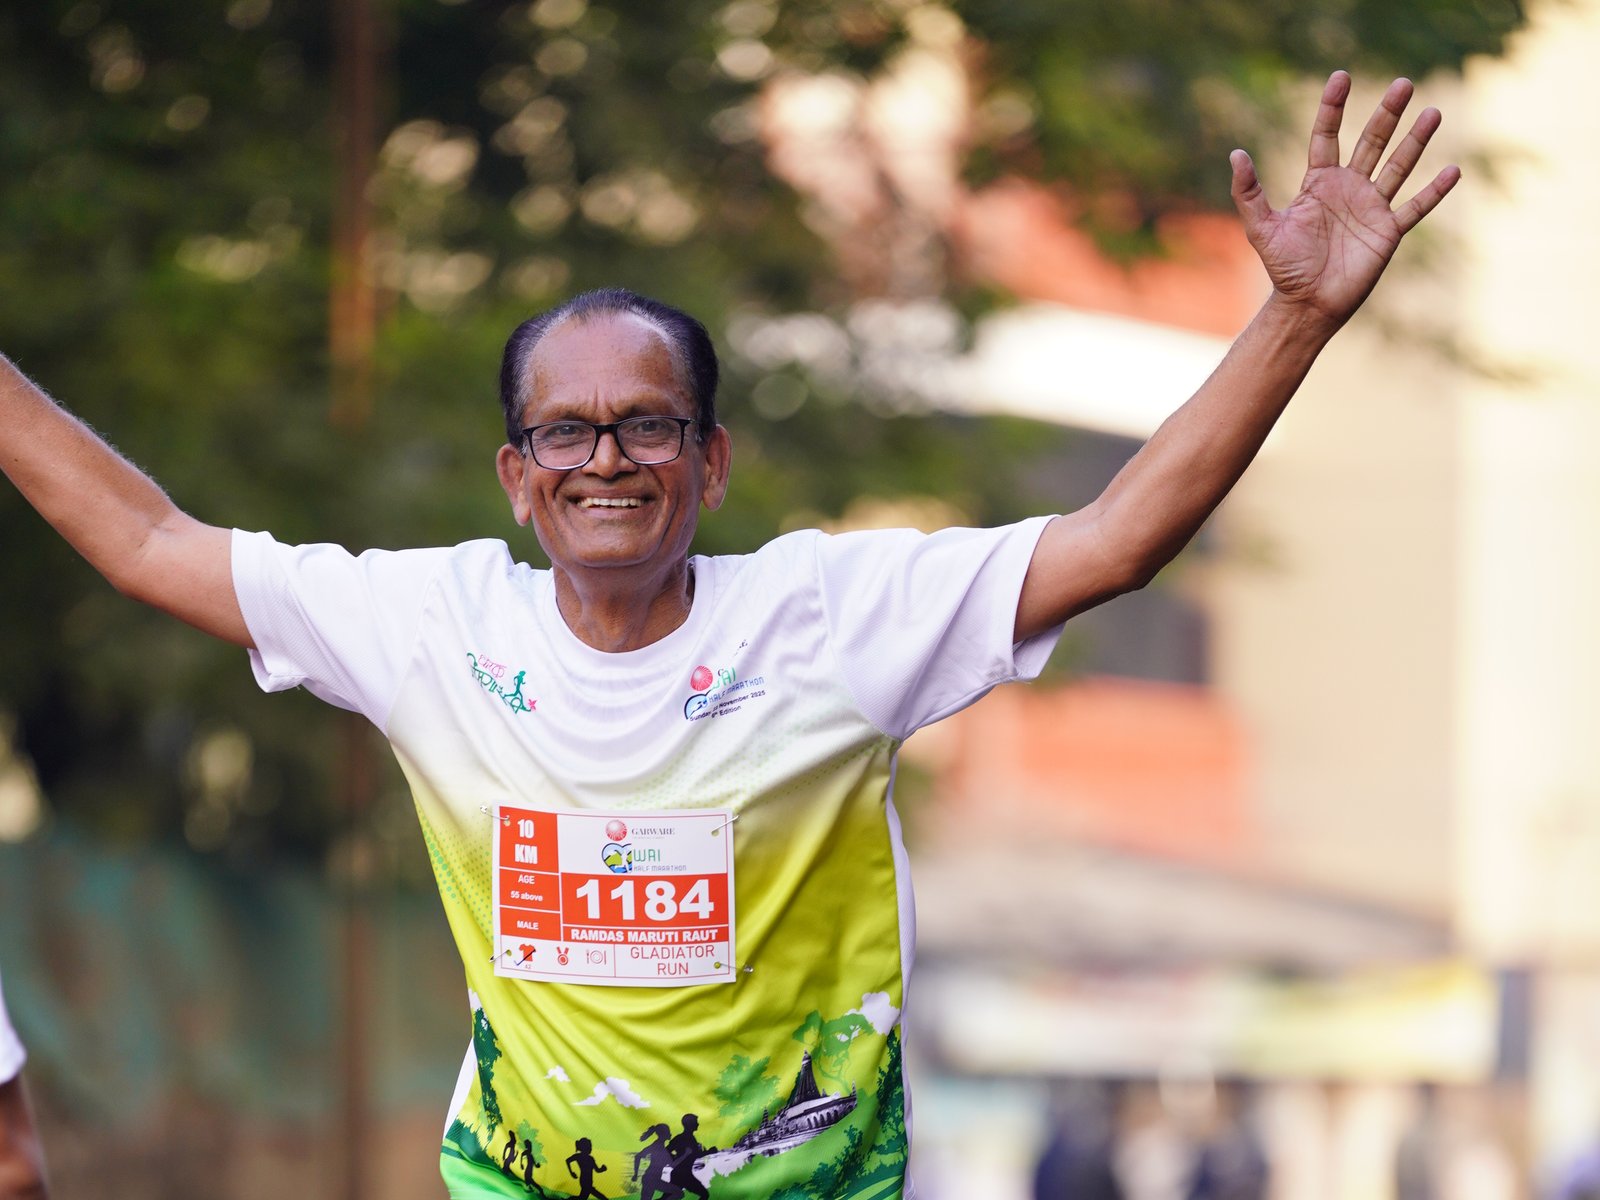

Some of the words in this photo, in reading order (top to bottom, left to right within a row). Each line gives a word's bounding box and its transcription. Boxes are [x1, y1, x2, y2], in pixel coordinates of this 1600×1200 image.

[719, 694, 749, 708] November
[517, 819, 535, 839] 10
[632, 828, 676, 836] GARWARE
[515, 843, 538, 864] KM
[633, 848, 661, 863] WAI
[651, 864, 687, 872] MARATHON
[518, 874, 536, 885] AGE
[510, 890, 520, 899] 55
[520, 892, 543, 902] above
[576, 878, 715, 921] 1184
[517, 920, 540, 930] MALE
[571, 929, 624, 942] RAMDAS
[628, 931, 679, 943] MARUTI
[682, 929, 718, 942] RAUT
[630, 945, 715, 960] GLADIATOR
[657, 963, 689, 975] RUN
